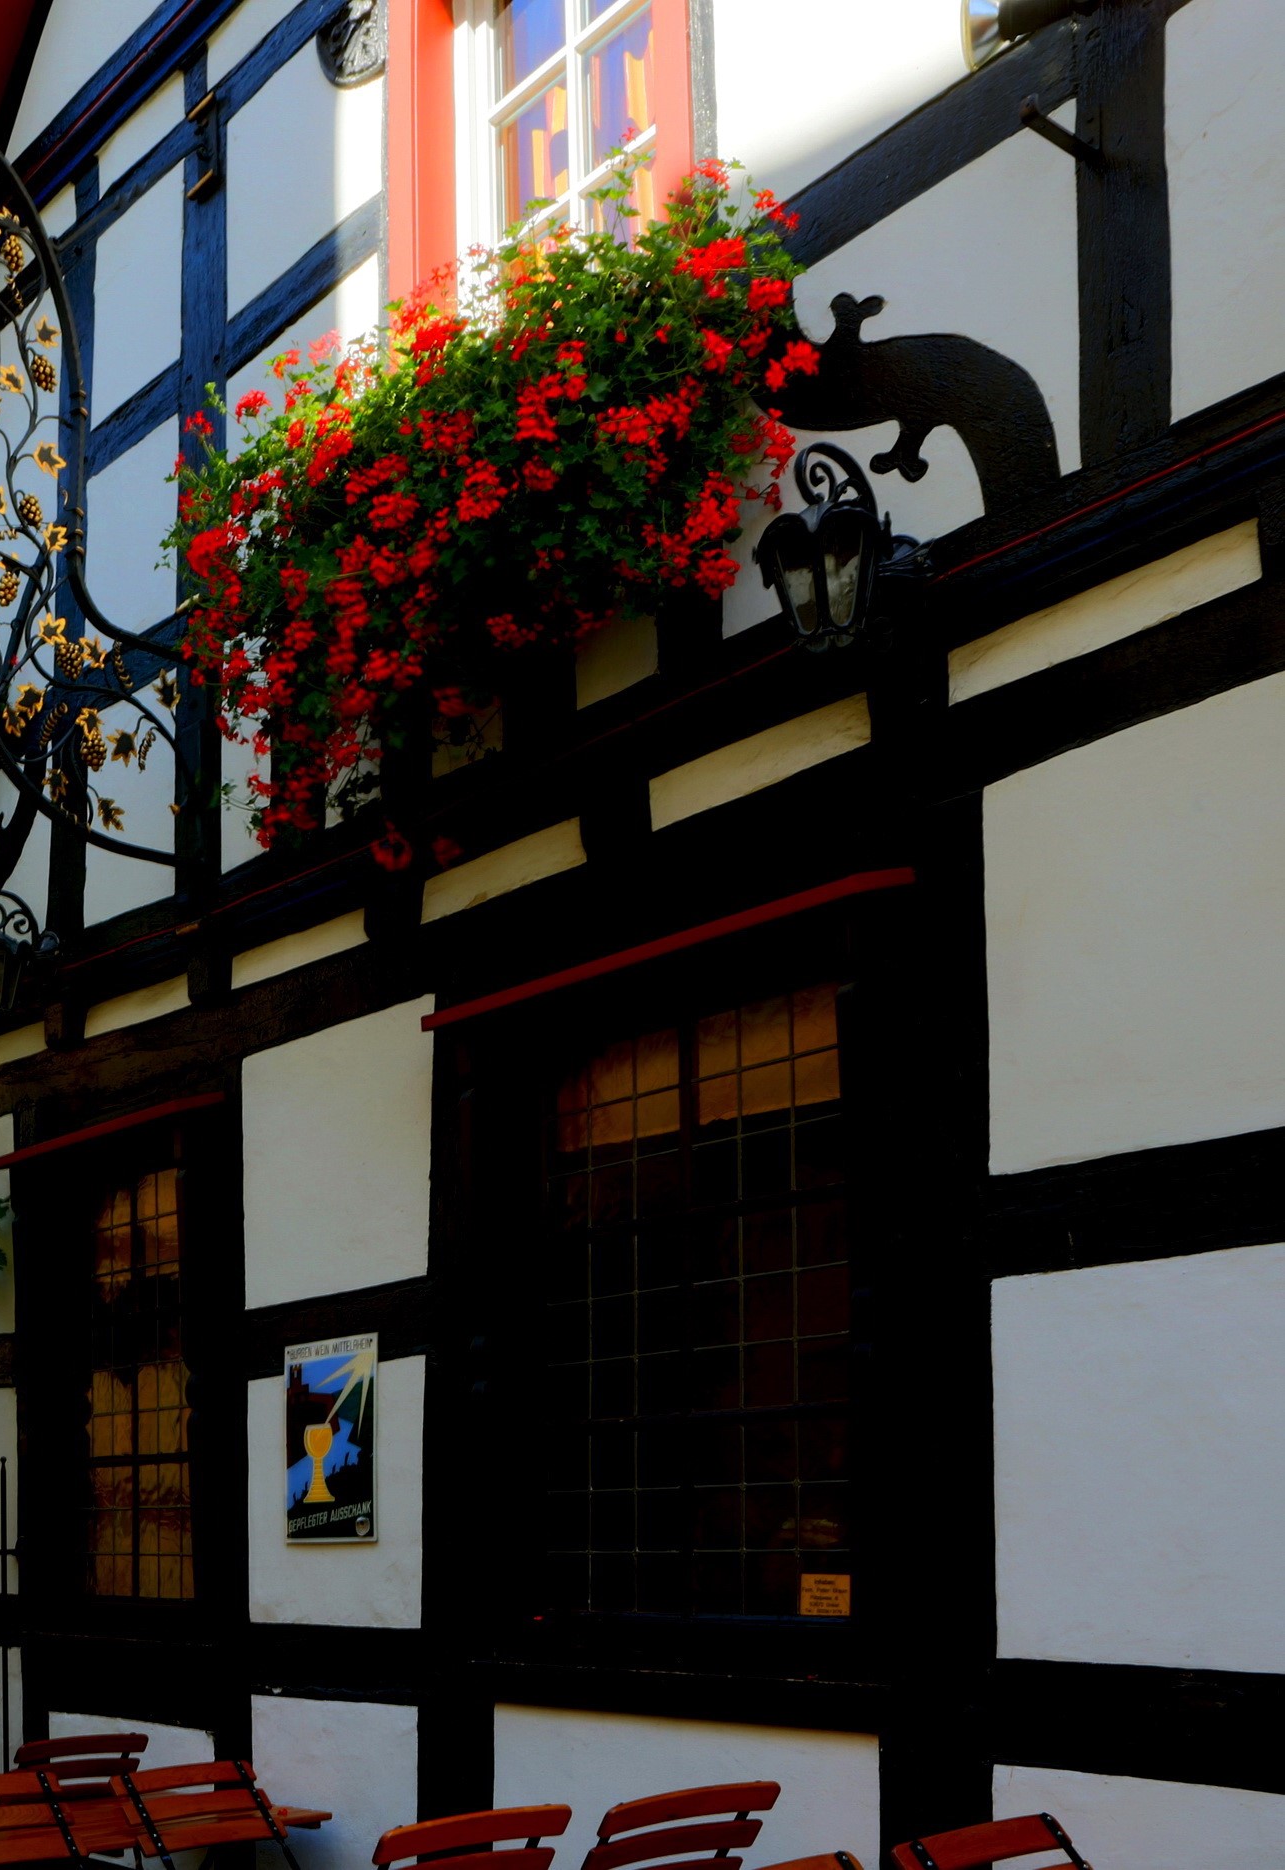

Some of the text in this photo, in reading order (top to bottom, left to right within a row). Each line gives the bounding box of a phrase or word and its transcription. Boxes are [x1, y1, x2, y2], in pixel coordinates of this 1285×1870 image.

[315, 1344, 330, 1356] WEIN
[331, 1338, 372, 1354] MITTELRHEIN
[288, 1500, 372, 1533] GEPFLEGTER AUSSCHANK
